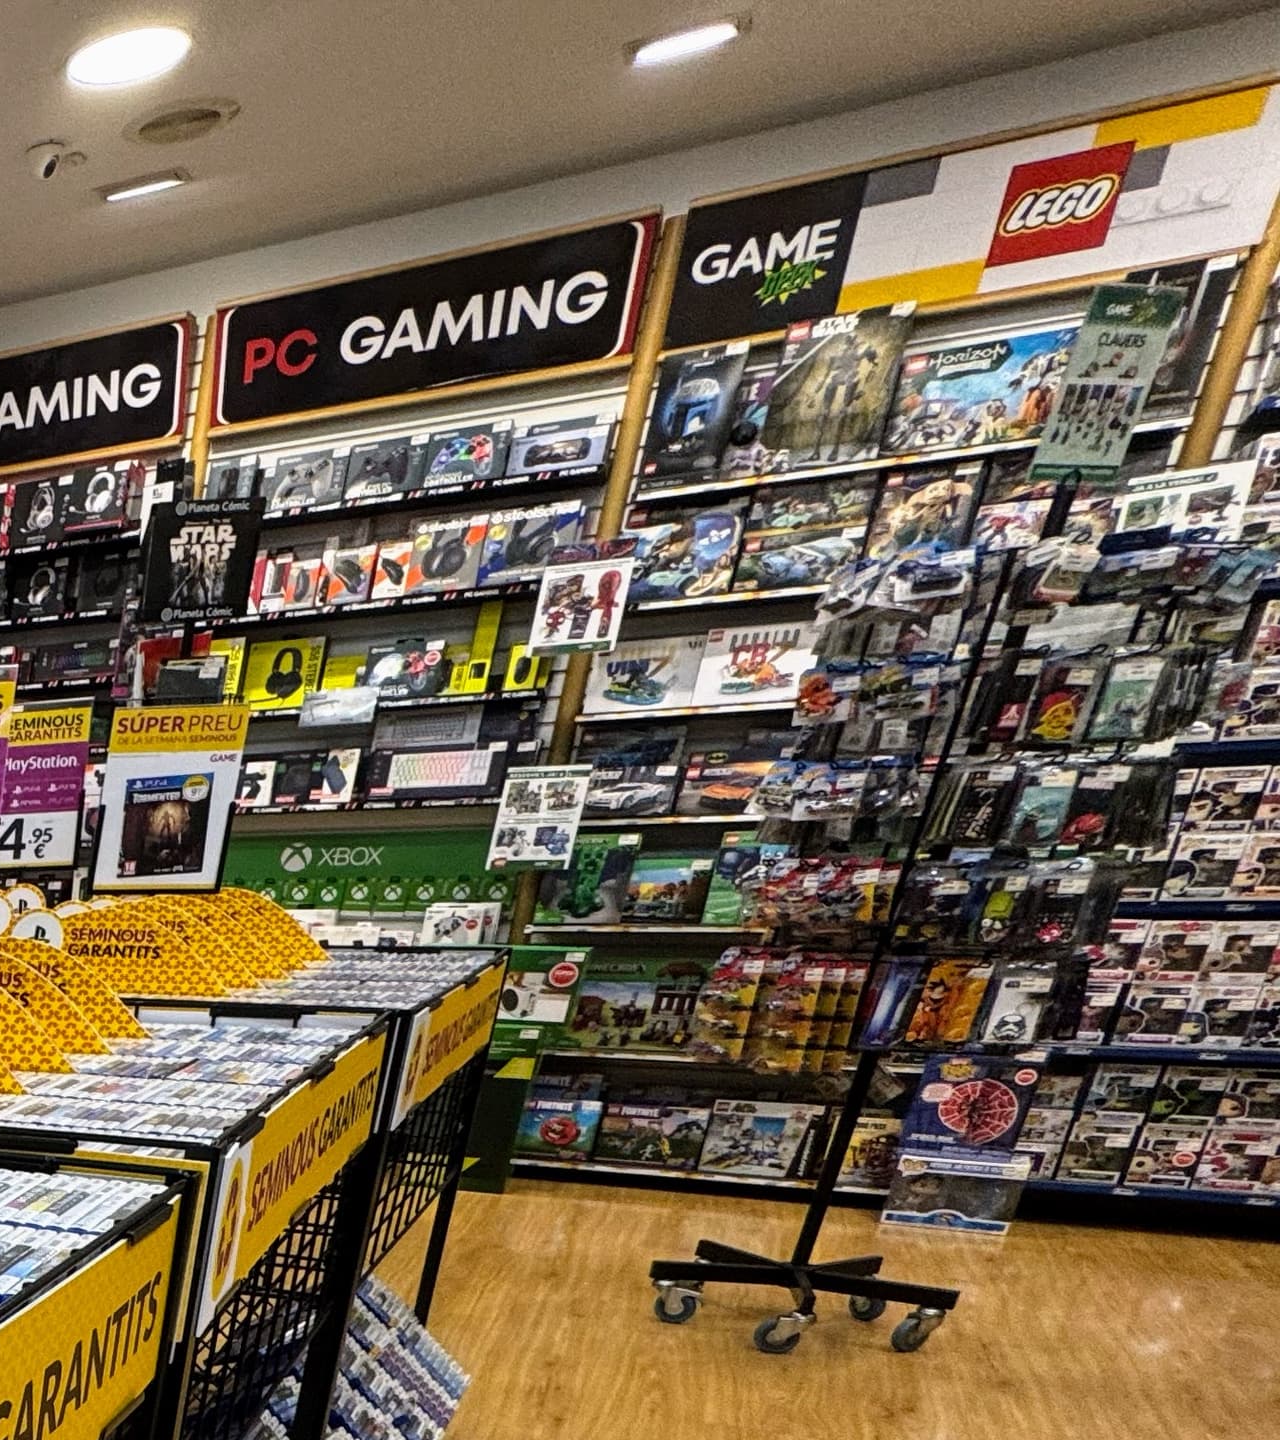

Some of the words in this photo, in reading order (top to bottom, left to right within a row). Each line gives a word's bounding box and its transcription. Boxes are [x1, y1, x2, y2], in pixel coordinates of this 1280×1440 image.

[1002, 173, 1118, 236] LEGO
[691, 219, 841, 285] GAME
[1105, 303, 1134, 317] GAME
[243, 329, 318, 384] PC
[340, 270, 608, 365] GAMING
[188, 501, 219, 514] Planeta
[220, 498, 251, 512] Cómic
[177, 524, 236, 546] STAR
[173, 608, 203, 620] Planeta
[204, 606, 234, 618] Cómic
[117, 712, 183, 735] SÚPER
[187, 714, 243, 733] PREU
[189, 733, 237, 743] SEMINOUS
[210, 753, 238, 763] GAME
[318, 846, 385, 866] XBOX
[69, 927, 156, 943] SEMINOUS
[67, 943, 161, 960] GARANTITS
[246, 1118, 320, 1232] SEMINOUS
[318, 1067, 378, 1151] GARANTITS
